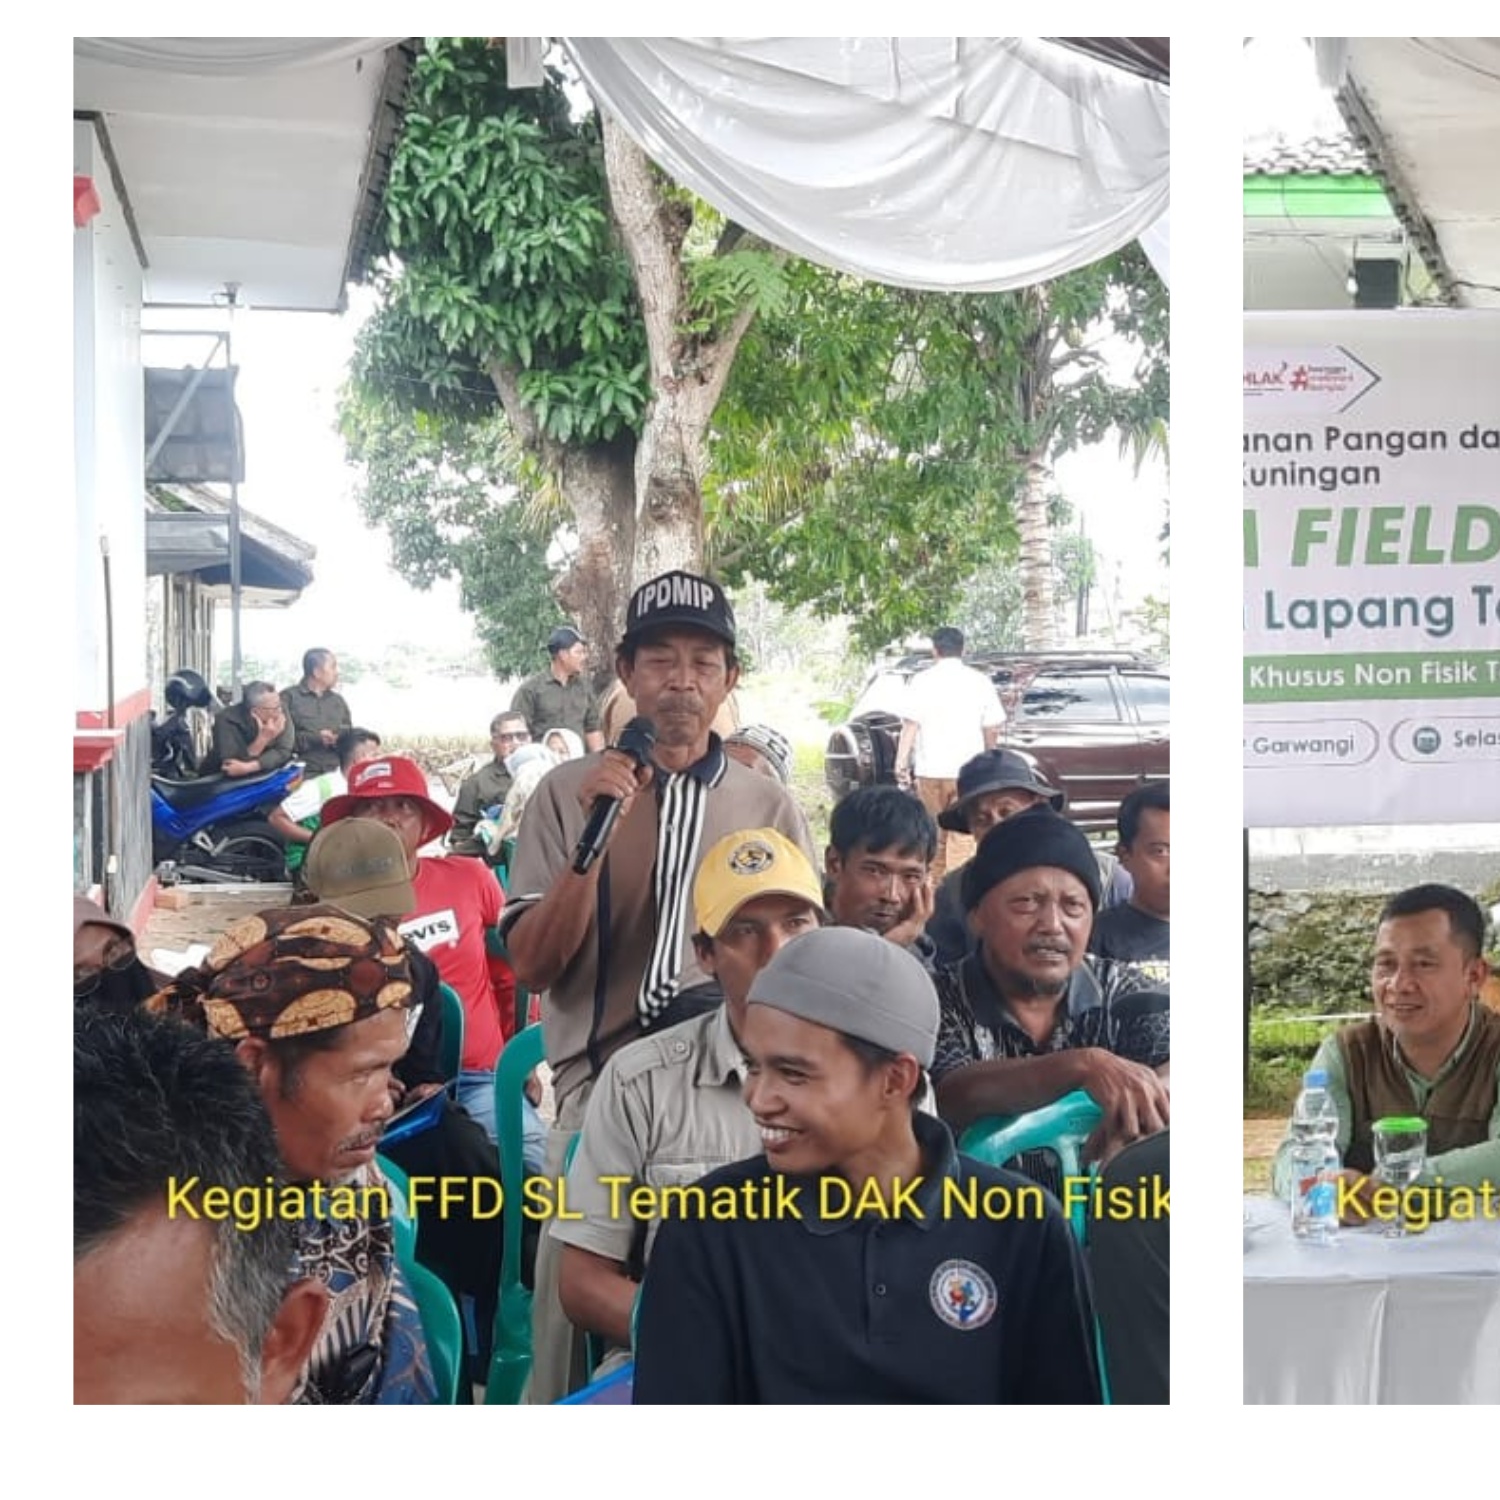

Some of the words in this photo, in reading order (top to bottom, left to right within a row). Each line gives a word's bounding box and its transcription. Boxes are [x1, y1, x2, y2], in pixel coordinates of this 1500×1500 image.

[1325, 425, 1447, 458] Pangan
[1243, 460, 1381, 492] uningan
[636, 576, 714, 618] IPDMIP
[1264, 589, 1455, 638] Lapang
[1249, 663, 1345, 689] Khusus
[1355, 662, 1411, 686] Non
[1420, 660, 1476, 684] Fisik
[1253, 734, 1355, 757] Garwangi
